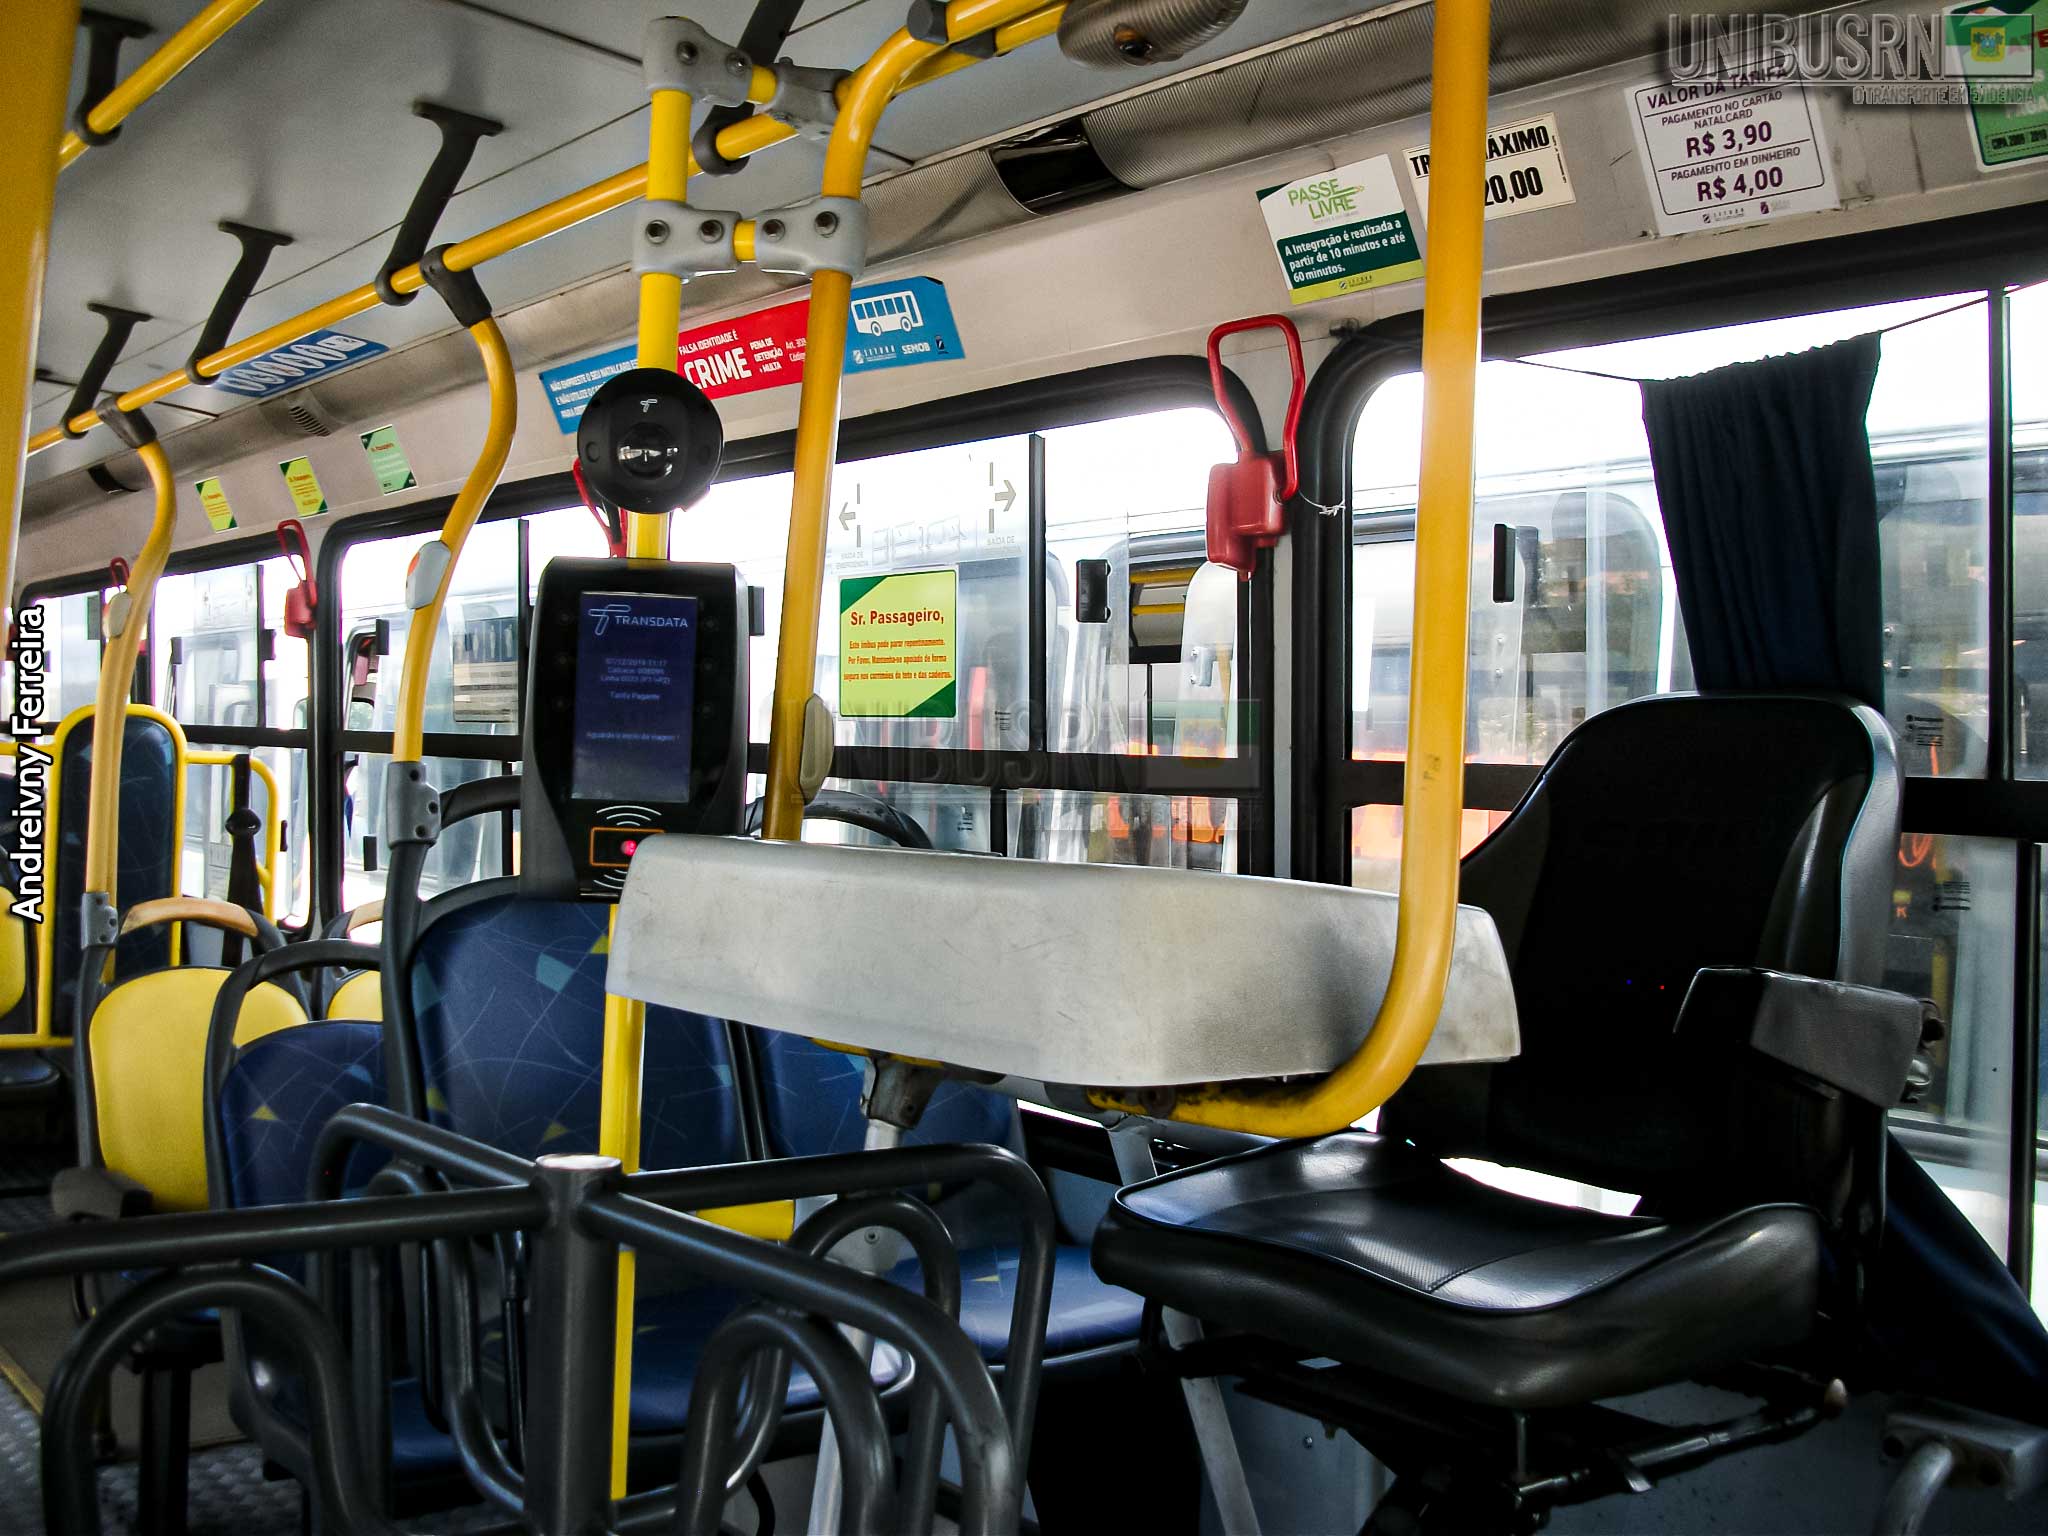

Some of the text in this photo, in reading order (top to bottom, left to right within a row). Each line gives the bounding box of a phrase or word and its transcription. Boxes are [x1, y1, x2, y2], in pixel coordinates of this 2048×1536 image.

[1648, 63, 1787, 108] VALOR DA TARIFA
[1661, 105, 1722, 126] PAGAMENTO
[1724, 100, 1740, 113] NO
[1694, 109, 1753, 129] NATALCARD
[1485, 125, 1550, 159] ÁXIMO
[1686, 121, 1773, 158] R$ 3,90
[1671, 146, 1801, 181] PAGAMENTO EM DINHEIRO
[1287, 179, 1341, 206] PASSE
[1697, 167, 1783, 201] R$ 4,00
[1308, 197, 1356, 220] LIVRE
[1285, 219, 1402, 257] A Integração é realizada a
[1289, 232, 1406, 272] partir de 10 minutos e até
[1293, 271, 1305, 283] 60
[1306, 264, 1346, 280] minutos.
[679, 343, 699, 356] FALSA
[698, 331, 734, 350] IDENTIDADE
[749, 339, 765, 350] PENA
[754, 347, 784, 362] DETENÇÃO
[901, 342, 931, 354] SEMOB
[683, 347, 752, 390] CRIME
[762, 362, 782, 373] MULTA
[615, 615, 688, 628] TRANSDATA
[850, 607, 944, 626] Sr. Passageiro,
[877, 641, 889, 650] pode
